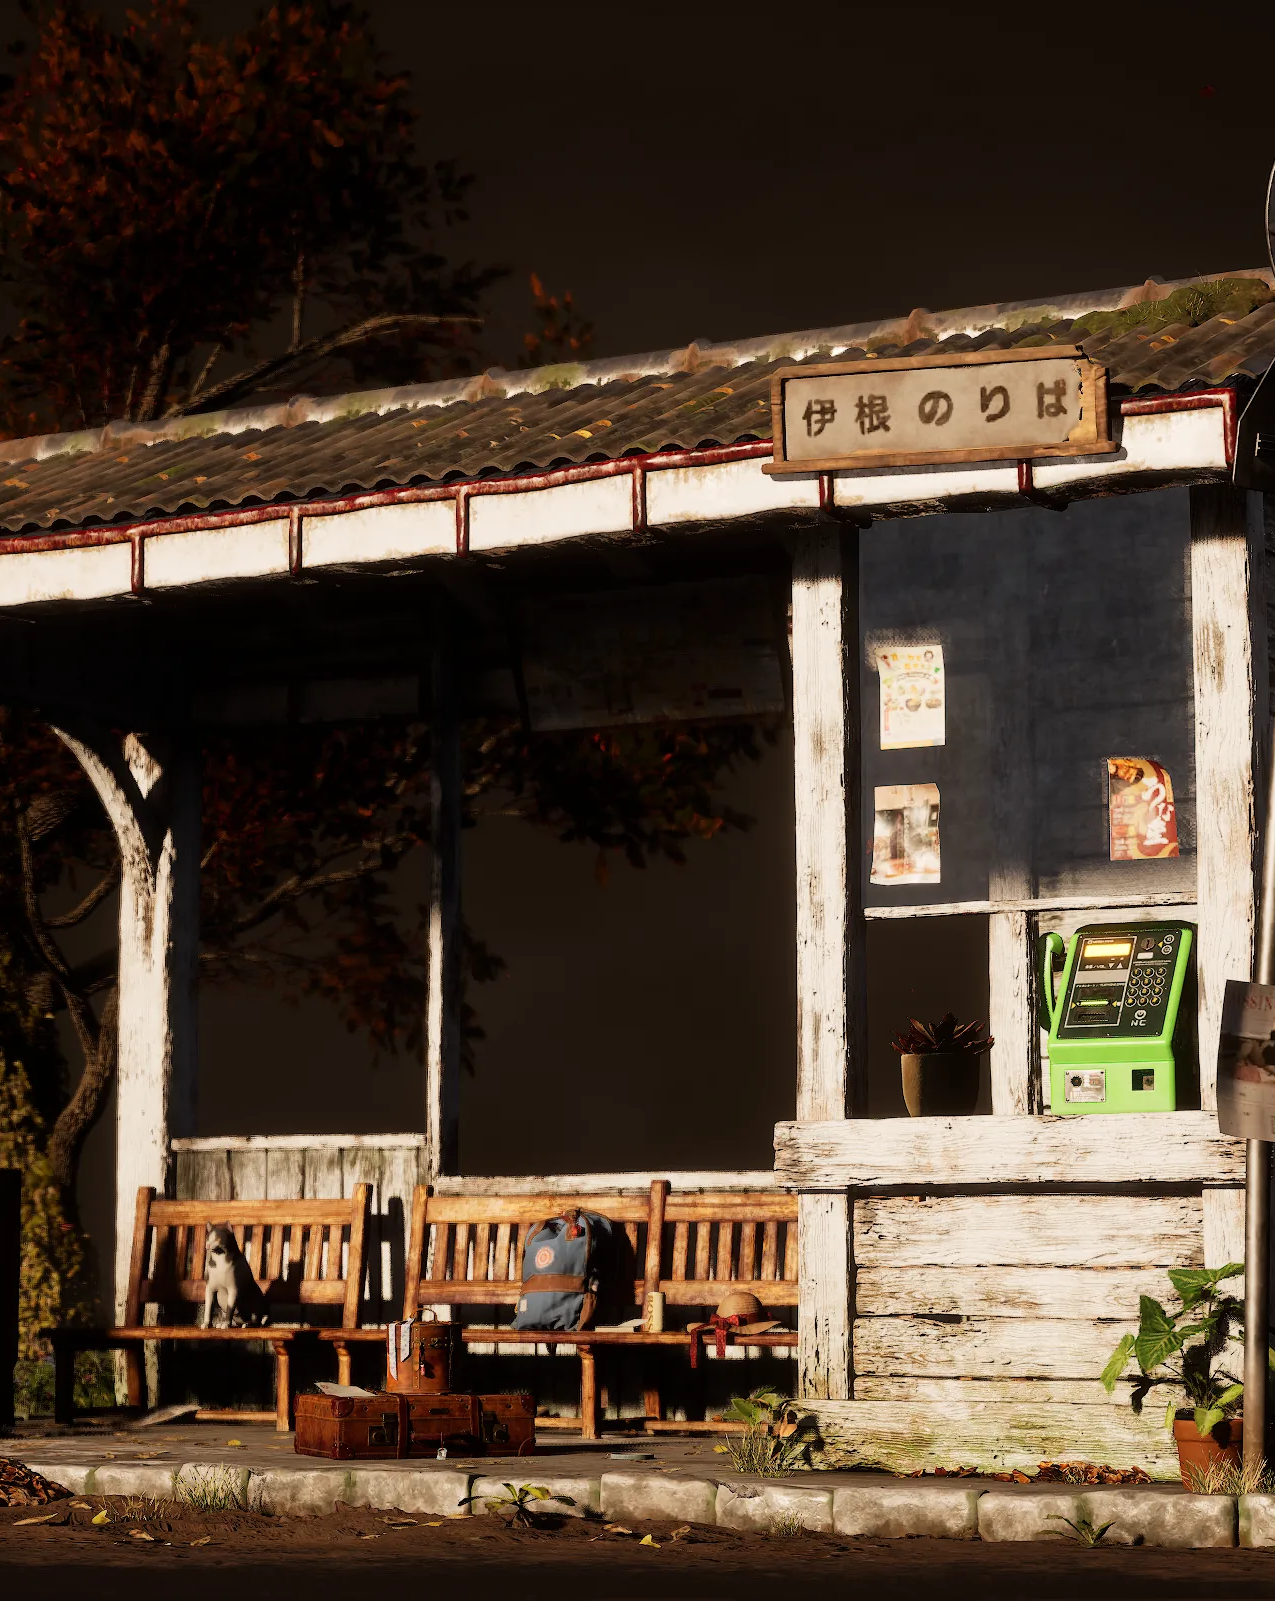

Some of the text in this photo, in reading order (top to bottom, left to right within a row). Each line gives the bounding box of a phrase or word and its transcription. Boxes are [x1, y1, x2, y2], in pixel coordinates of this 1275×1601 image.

[802, 378, 1067, 437] 伊根のりば
